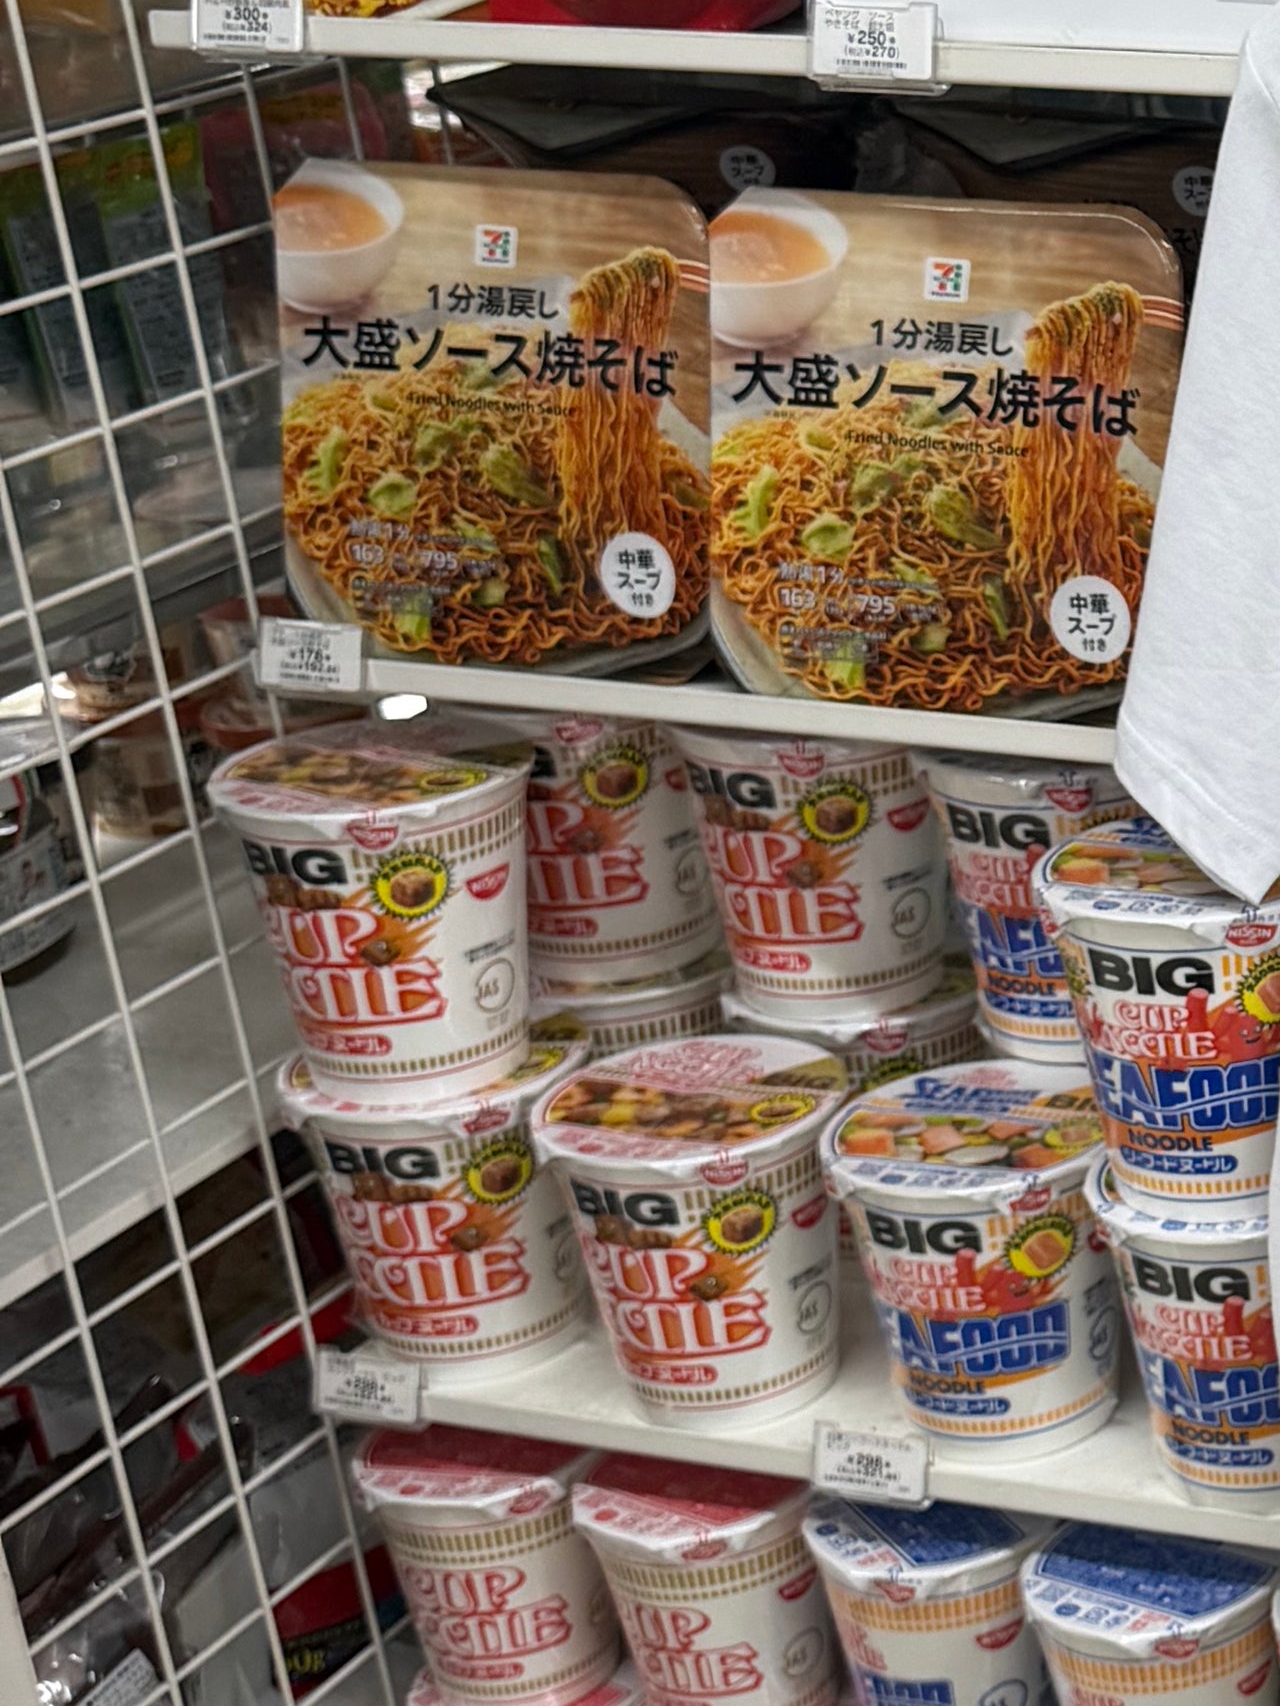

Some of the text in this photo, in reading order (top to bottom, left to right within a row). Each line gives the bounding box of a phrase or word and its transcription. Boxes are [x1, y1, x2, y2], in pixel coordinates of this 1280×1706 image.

[425, 282, 559, 322] 1分湯戻し
[301, 315, 680, 399] 大盛ソース焼そば
[869, 319, 1013, 358] 1分湯戻し
[732, 351, 1140, 438] 大盛ソース焼そば
[615, 546, 657, 572] 中華
[614, 569, 663, 592] スープ
[1068, 592, 1111, 615] 中華
[1065, 614, 1118, 637] スープ
[947, 803, 1052, 852] BIG
[244, 841, 349, 887] BIG
[1091, 947, 1216, 998] BIG
[1127, 1130, 1215, 1154] NOODLE
[327, 1143, 439, 1182] BIG
[580, 1189, 678, 1227] BIG
[866, 1210, 983, 1255] BIG
[1134, 1256, 1253, 1303] BIG
